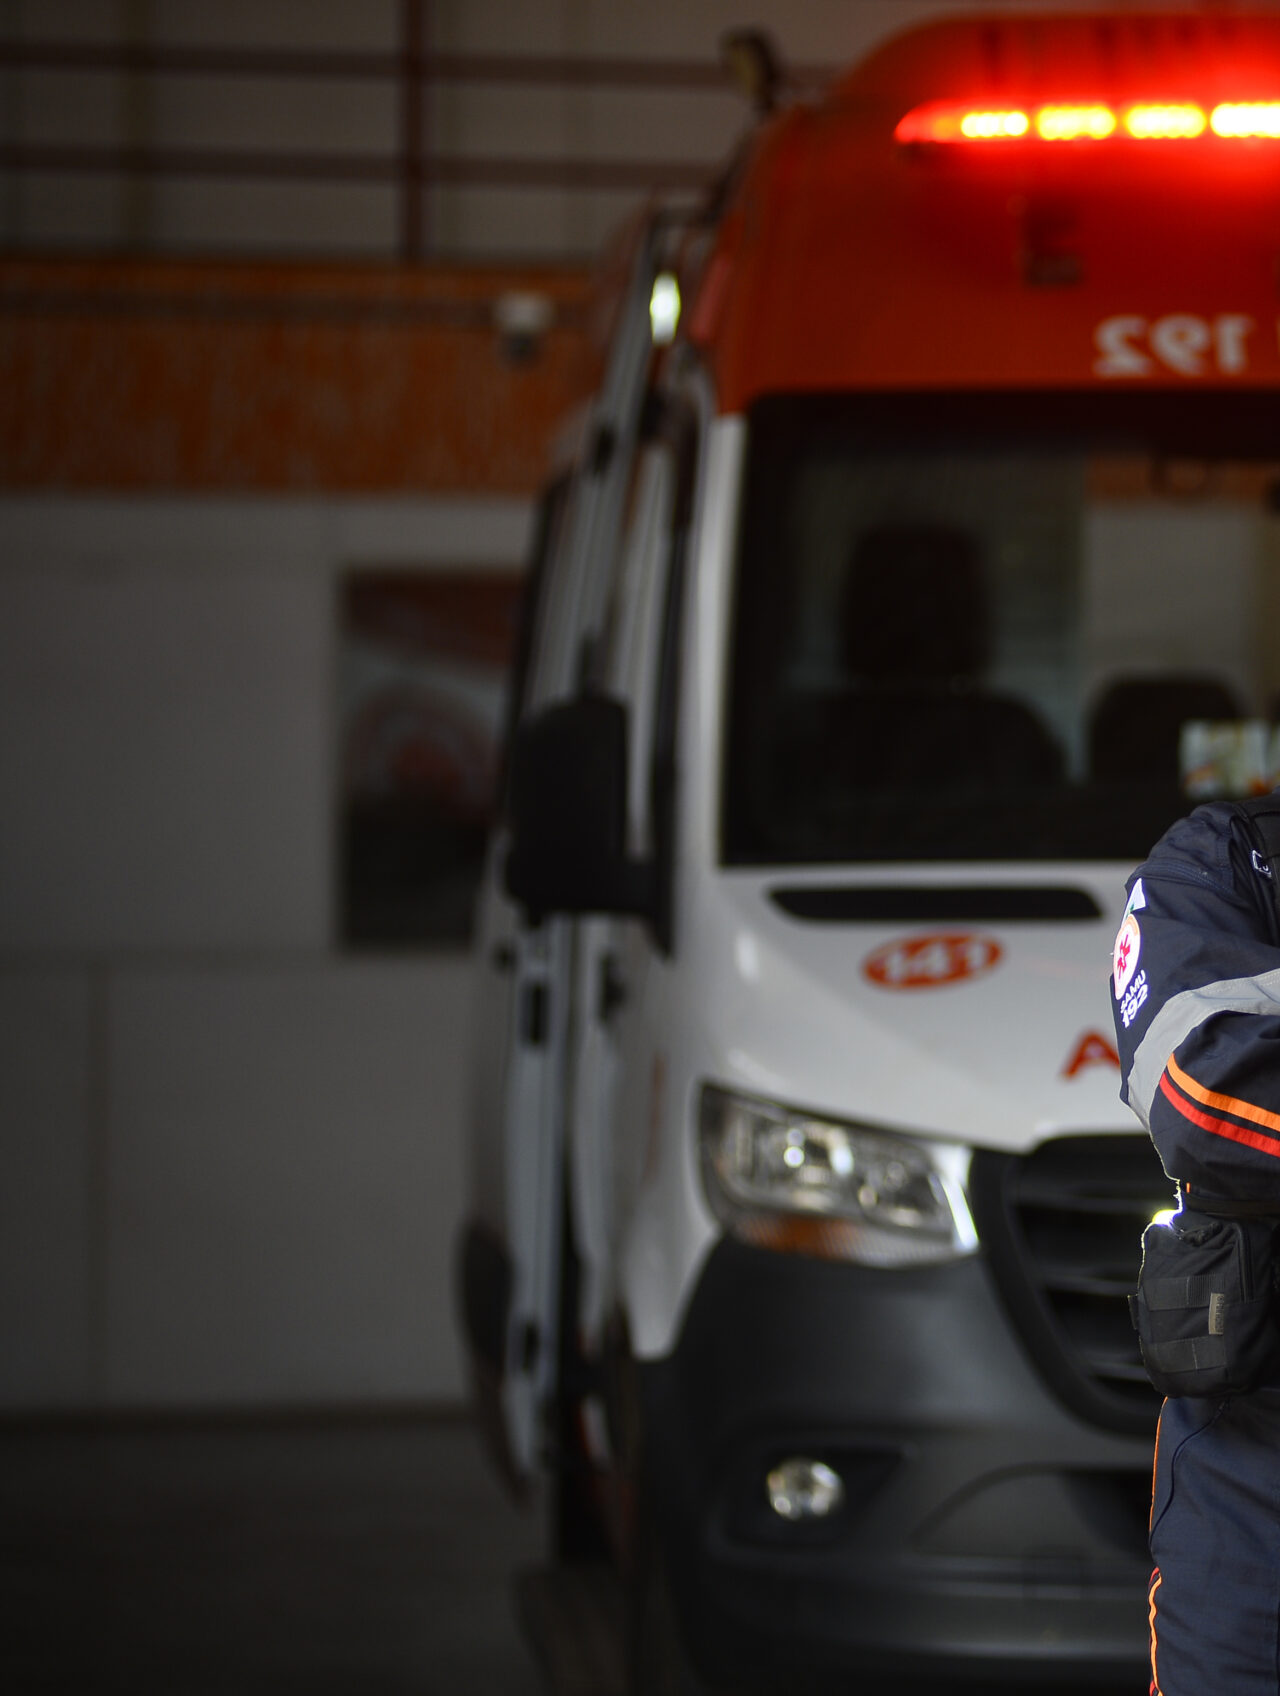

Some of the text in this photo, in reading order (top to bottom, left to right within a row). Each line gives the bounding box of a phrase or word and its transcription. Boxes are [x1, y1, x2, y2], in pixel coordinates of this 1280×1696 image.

[883, 940, 988, 983] 141
[1120, 969, 1146, 1014] SAMU
[1122, 984, 1148, 1028] 192
